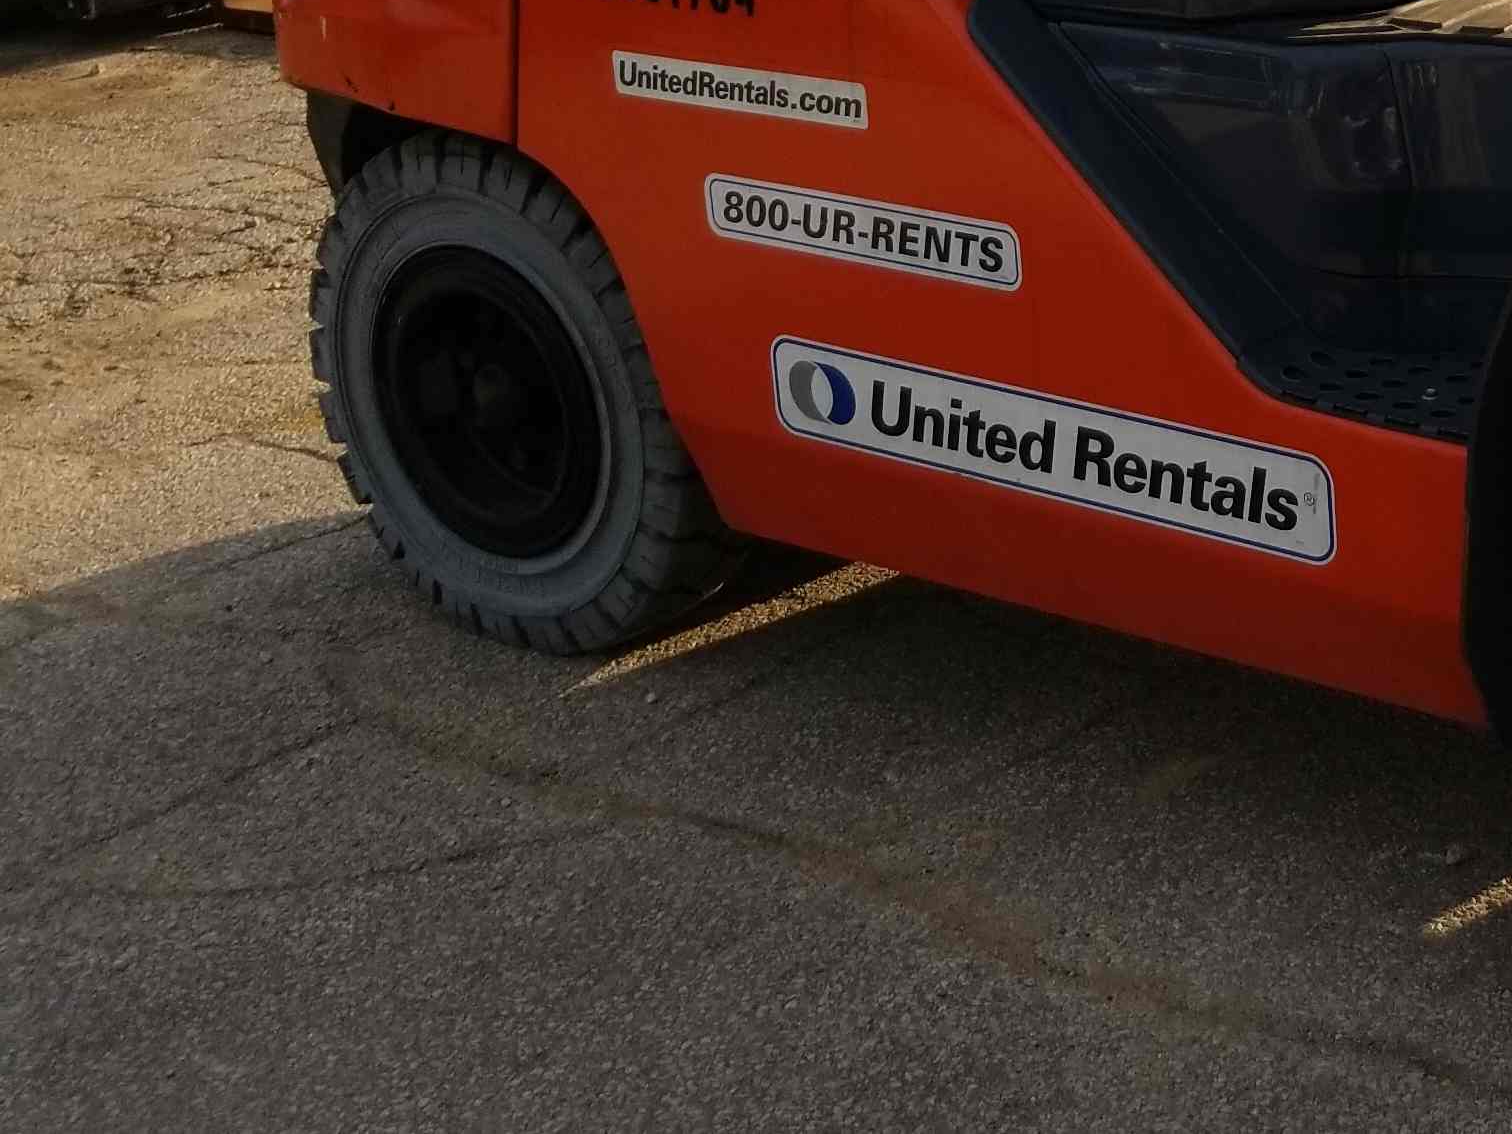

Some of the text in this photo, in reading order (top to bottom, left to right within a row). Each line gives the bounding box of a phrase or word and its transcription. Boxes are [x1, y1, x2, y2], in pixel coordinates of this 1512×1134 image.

[619, 59, 862, 118] UnitedRentals.com
[722, 190, 1004, 272] 800-UR-RENTS
[871, 378, 1056, 473] United
